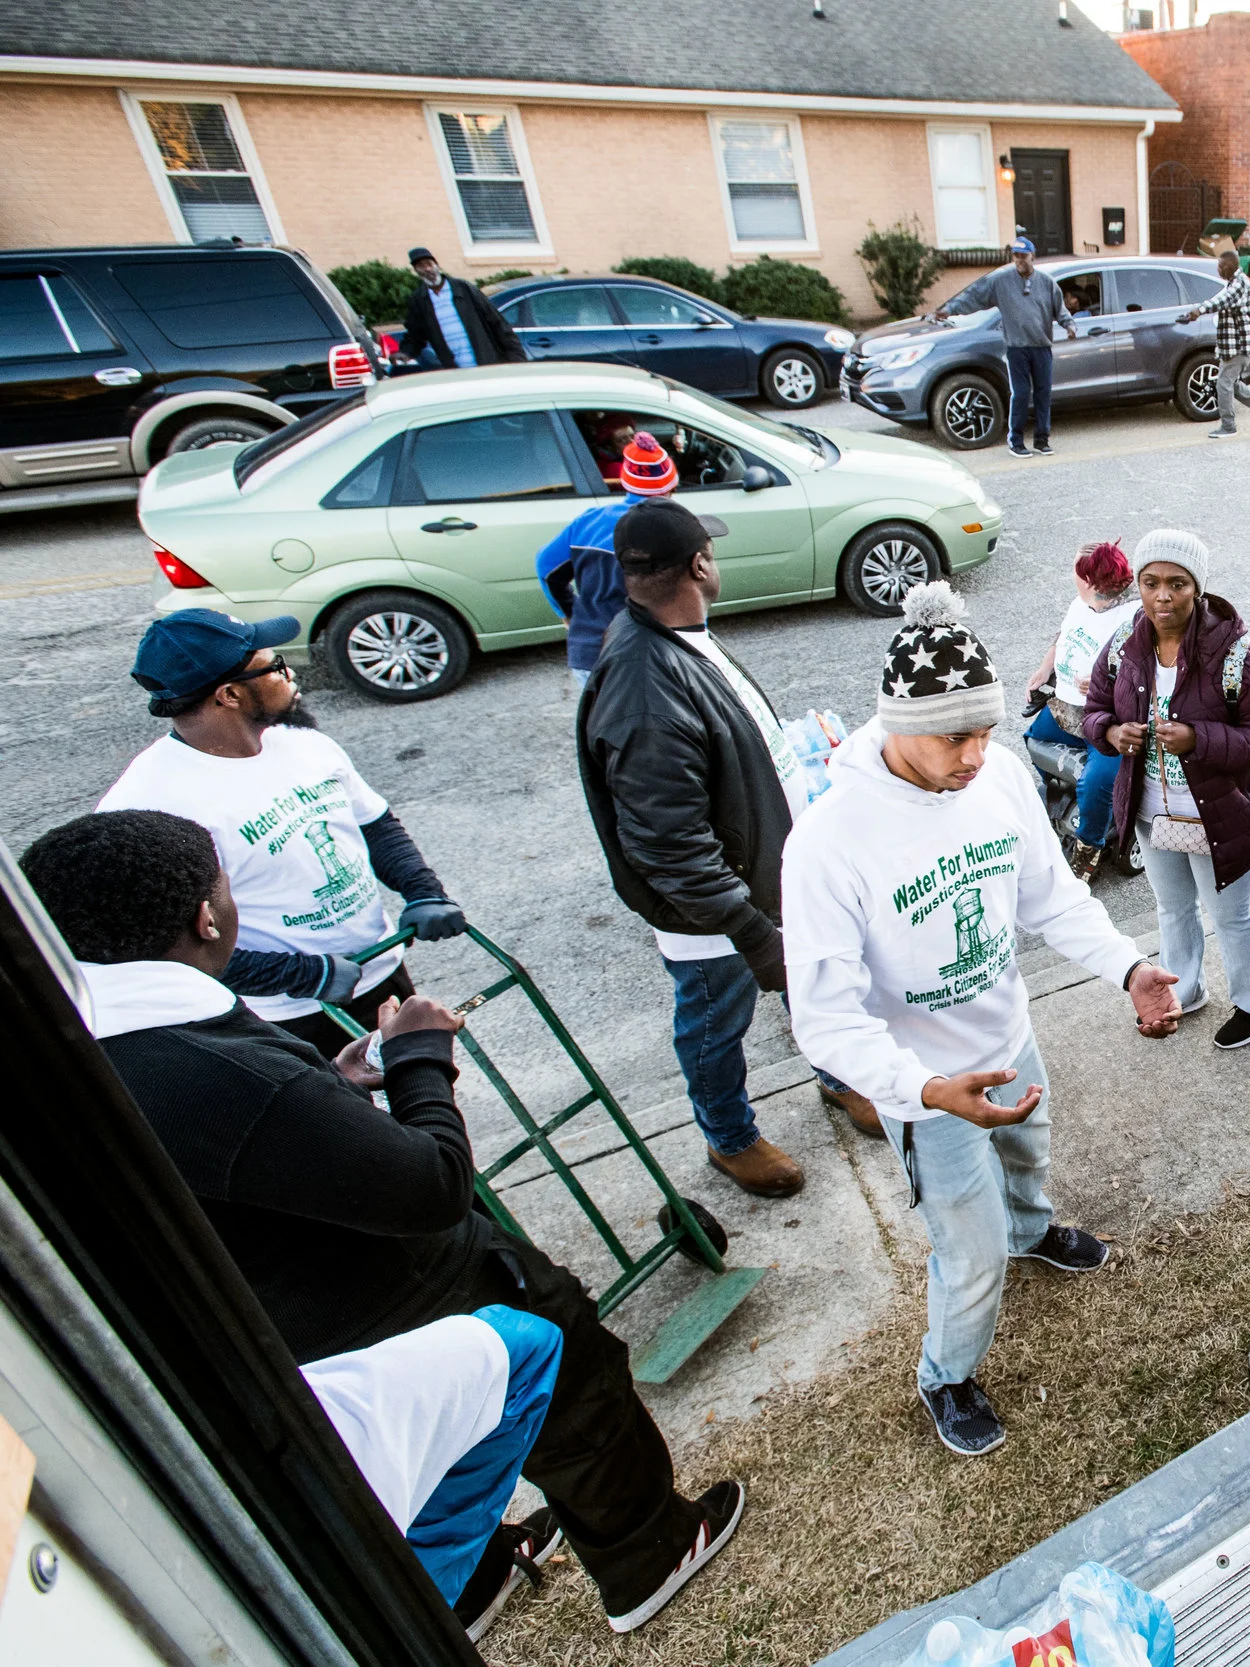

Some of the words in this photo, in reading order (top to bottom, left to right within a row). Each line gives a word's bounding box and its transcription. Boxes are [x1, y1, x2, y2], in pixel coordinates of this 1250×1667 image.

[1166, 768, 1176, 778] For
[238, 808, 282, 845] Water
[892, 869, 937, 914] Water
[938, 854, 960, 881] For
[910, 861, 1015, 927] #justice4denmark
[282, 905, 332, 927] Denmark
[310, 921, 335, 931] Crisis
[905, 984, 952, 1004] Denmark
[954, 970, 988, 994] Citizens
[928, 1000, 952, 1012] Crisis
